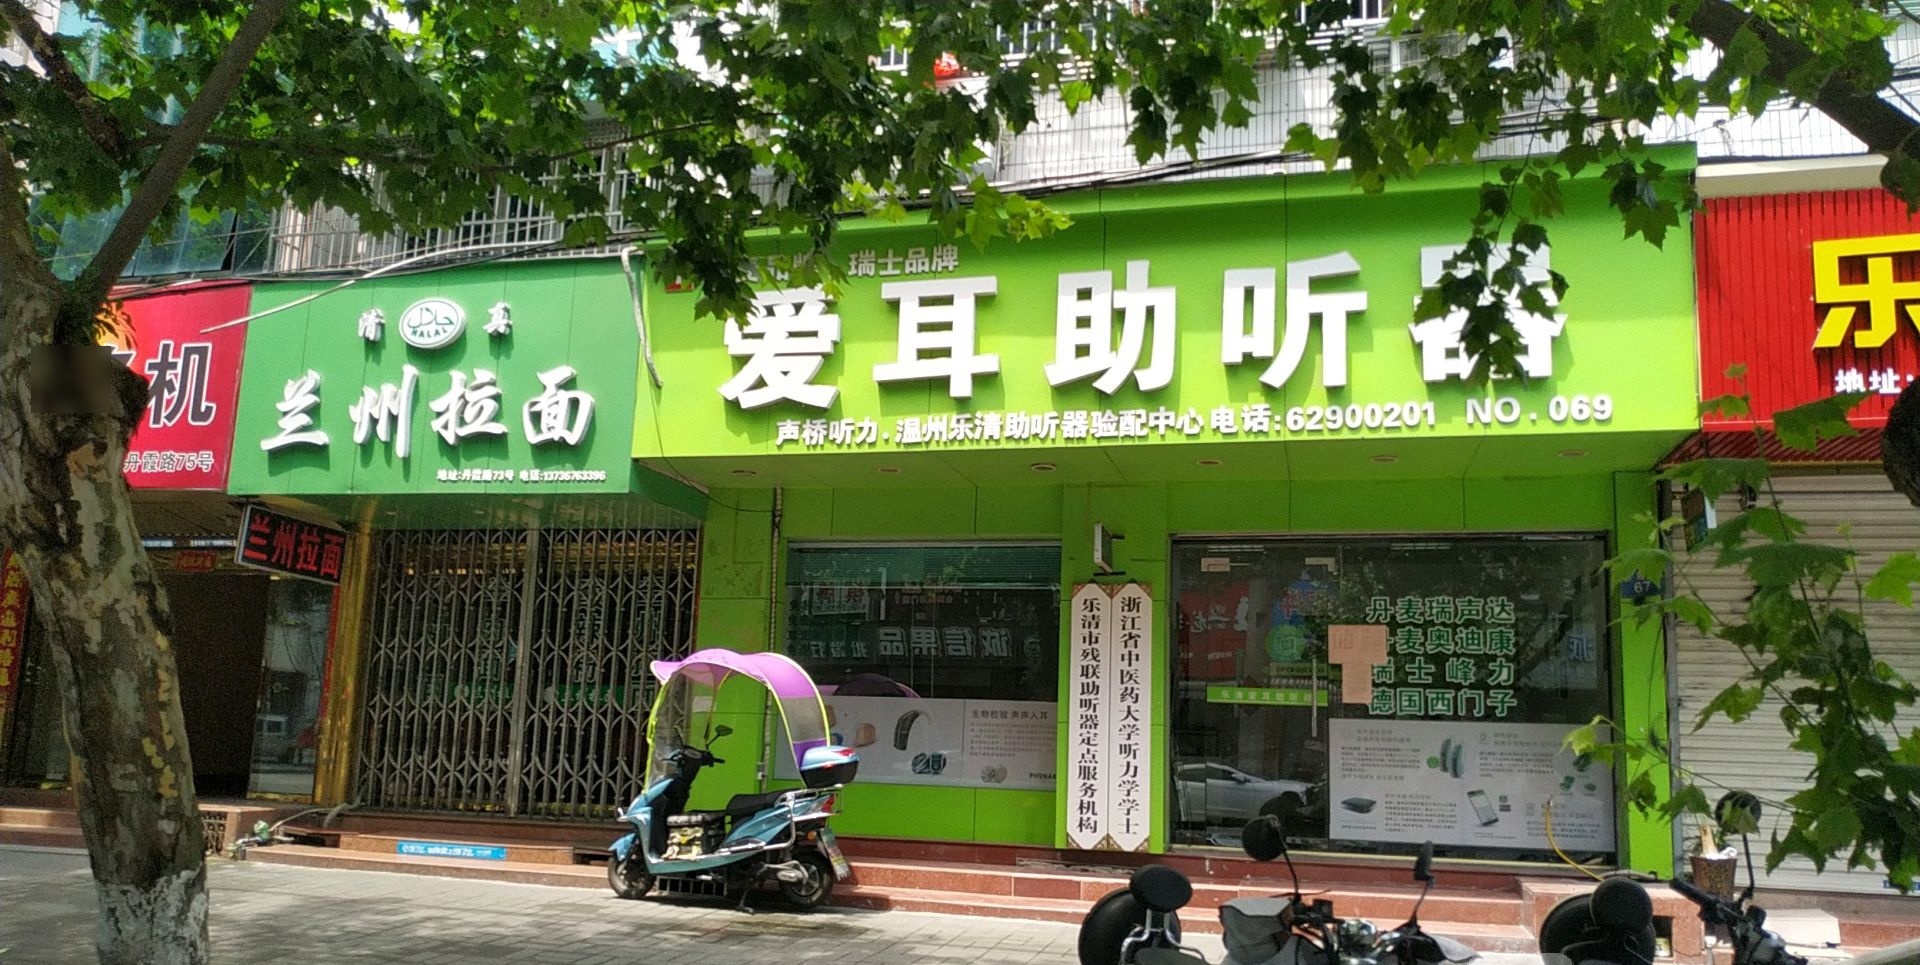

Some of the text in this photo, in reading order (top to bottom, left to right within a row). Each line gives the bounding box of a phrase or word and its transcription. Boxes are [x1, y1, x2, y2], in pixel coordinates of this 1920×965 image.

[848, 245, 958, 277] 瑞士品牌
[1812, 233, 1920, 350] 乐
[358, 301, 513, 342] 清 真
[410, 327, 449, 339] HALAL
[717, 243, 1568, 410] 爱耳助听器
[260, 364, 595, 458] 兰州拉面
[1211, 401, 1435, 433] 电话:62900201
[1549, 394, 1613, 421] 069
[123, 451, 214, 472] 丹霞路75号
[243, 513, 344, 580] 兰州拉面
[1634, 581, 1651, 593] 67
[1366, 596, 1515, 624] 丹麦瑞声达
[1387, 626, 1516, 655] 麦奥迪康
[1076, 597, 1101, 834] 乐清市残联助听器定点服务机构
[1118, 596, 1142, 835] 浙江省中医药大学听力学学士
[1369, 687, 1517, 716] 德国西门子
